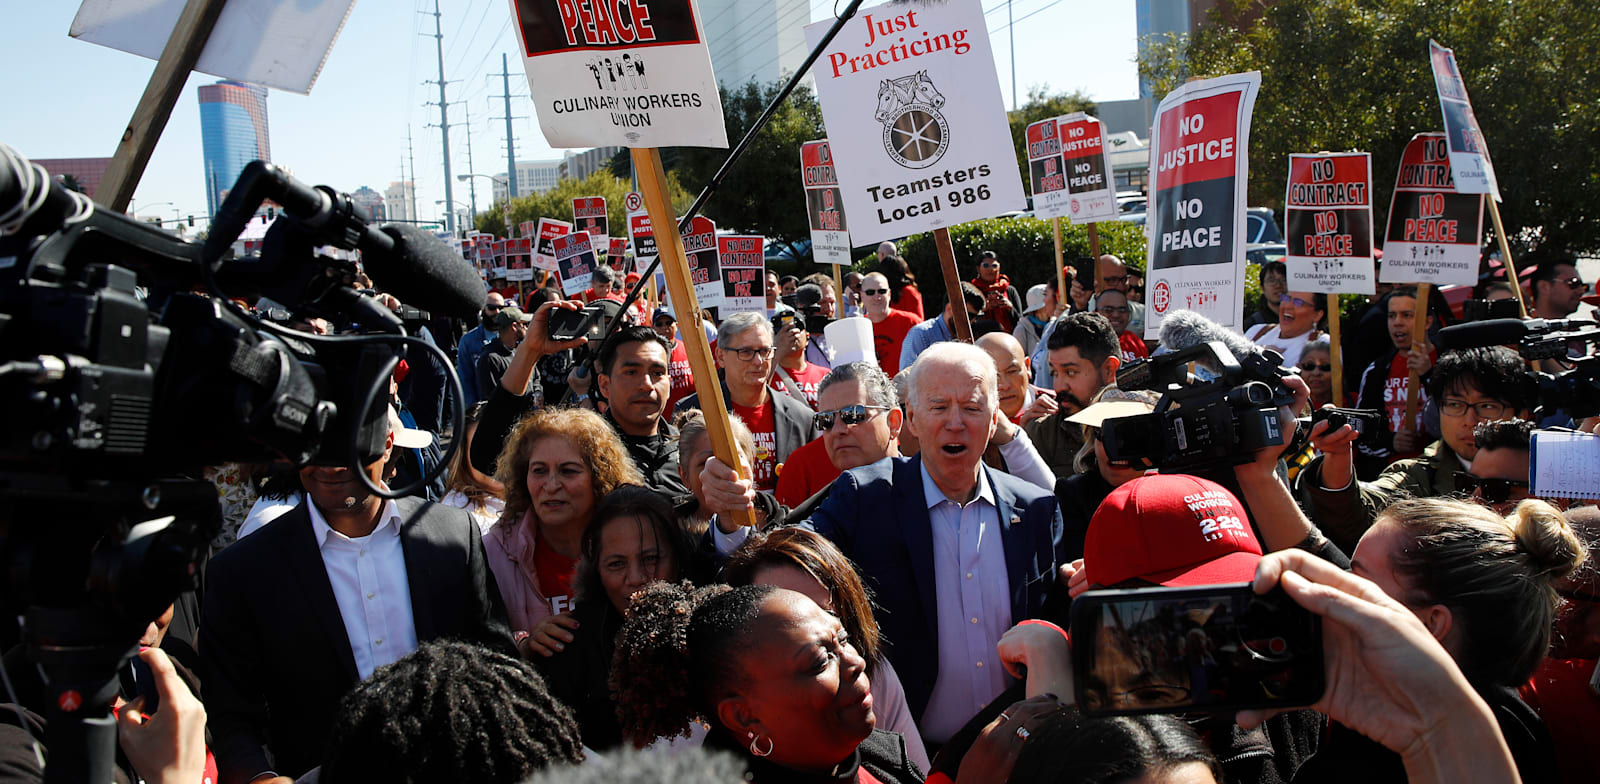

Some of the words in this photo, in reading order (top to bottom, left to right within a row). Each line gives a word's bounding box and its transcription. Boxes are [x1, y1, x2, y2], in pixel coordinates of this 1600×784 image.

[556, 0, 656, 46] PEACE
[863, 9, 919, 47] Just
[827, 29, 971, 78] Practicing
[553, 95, 619, 114] CULINARY
[623, 93, 702, 110] WORKERS
[891, 105, 935, 121] BROTHERHOOD
[611, 112, 651, 127] UNION
[1179, 113, 1204, 138] NO
[1041, 122, 1053, 140] NO
[1069, 127, 1084, 138] NO
[885, 122, 907, 165] INTERNATIONAL
[1030, 138, 1060, 157] CONTRA
[1063, 137, 1101, 152] JUSTICE
[1424, 139, 1449, 162] NO
[1160, 137, 1233, 172] JUSTICE
[806, 166, 838, 185] CONTRA
[1044, 158, 1056, 175] NO
[1075, 163, 1090, 174] NO
[1312, 159, 1335, 183] NO
[1402, 164, 1455, 187] CONTRA
[867, 164, 991, 202] Teamsters
[1041, 174, 1063, 192] PEACE
[1070, 174, 1102, 187] PEACE
[1291, 182, 1365, 205] CONTRACT
[878, 196, 941, 225] Local
[947, 184, 991, 207] 986
[1177, 198, 1203, 220] NO
[1419, 194, 1444, 218] NO
[1314, 211, 1338, 234] NO
[1404, 218, 1458, 241] PEACE
[682, 233, 713, 251] TRACT
[727, 240, 738, 251] NO
[741, 240, 755, 250] HAY
[1162, 226, 1221, 252] PEACE
[1304, 234, 1352, 256] PEACE
[720, 253, 761, 265] CONTRATO
[1428, 261, 1469, 269] WORKERS
[691, 268, 709, 285] ACE
[728, 271, 740, 283] NO
[1414, 267, 1439, 275] UNION
[735, 284, 751, 297] PAZ
[668, 360, 689, 369] EGAS
[1385, 377, 1401, 389] UR
[281, 405, 307, 424] SONY
